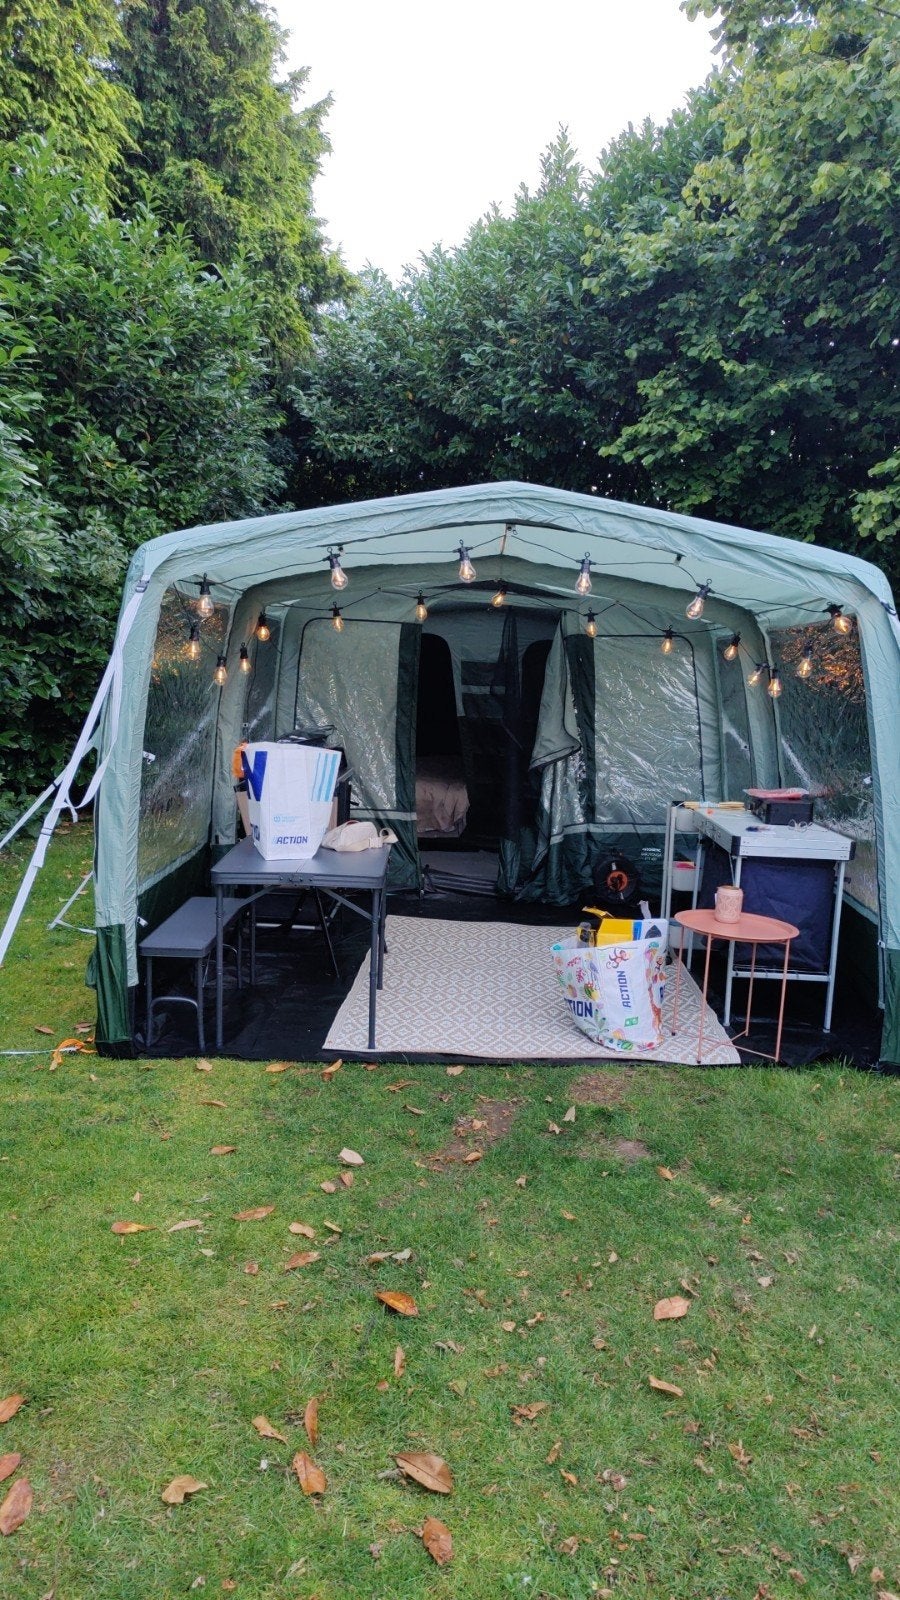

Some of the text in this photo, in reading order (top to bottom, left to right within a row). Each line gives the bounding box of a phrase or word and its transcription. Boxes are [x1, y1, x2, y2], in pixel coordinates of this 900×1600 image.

[276, 836, 308, 845] ACTION
[616, 970, 632, 1008] ACTION
[563, 998, 593, 1018] TION
